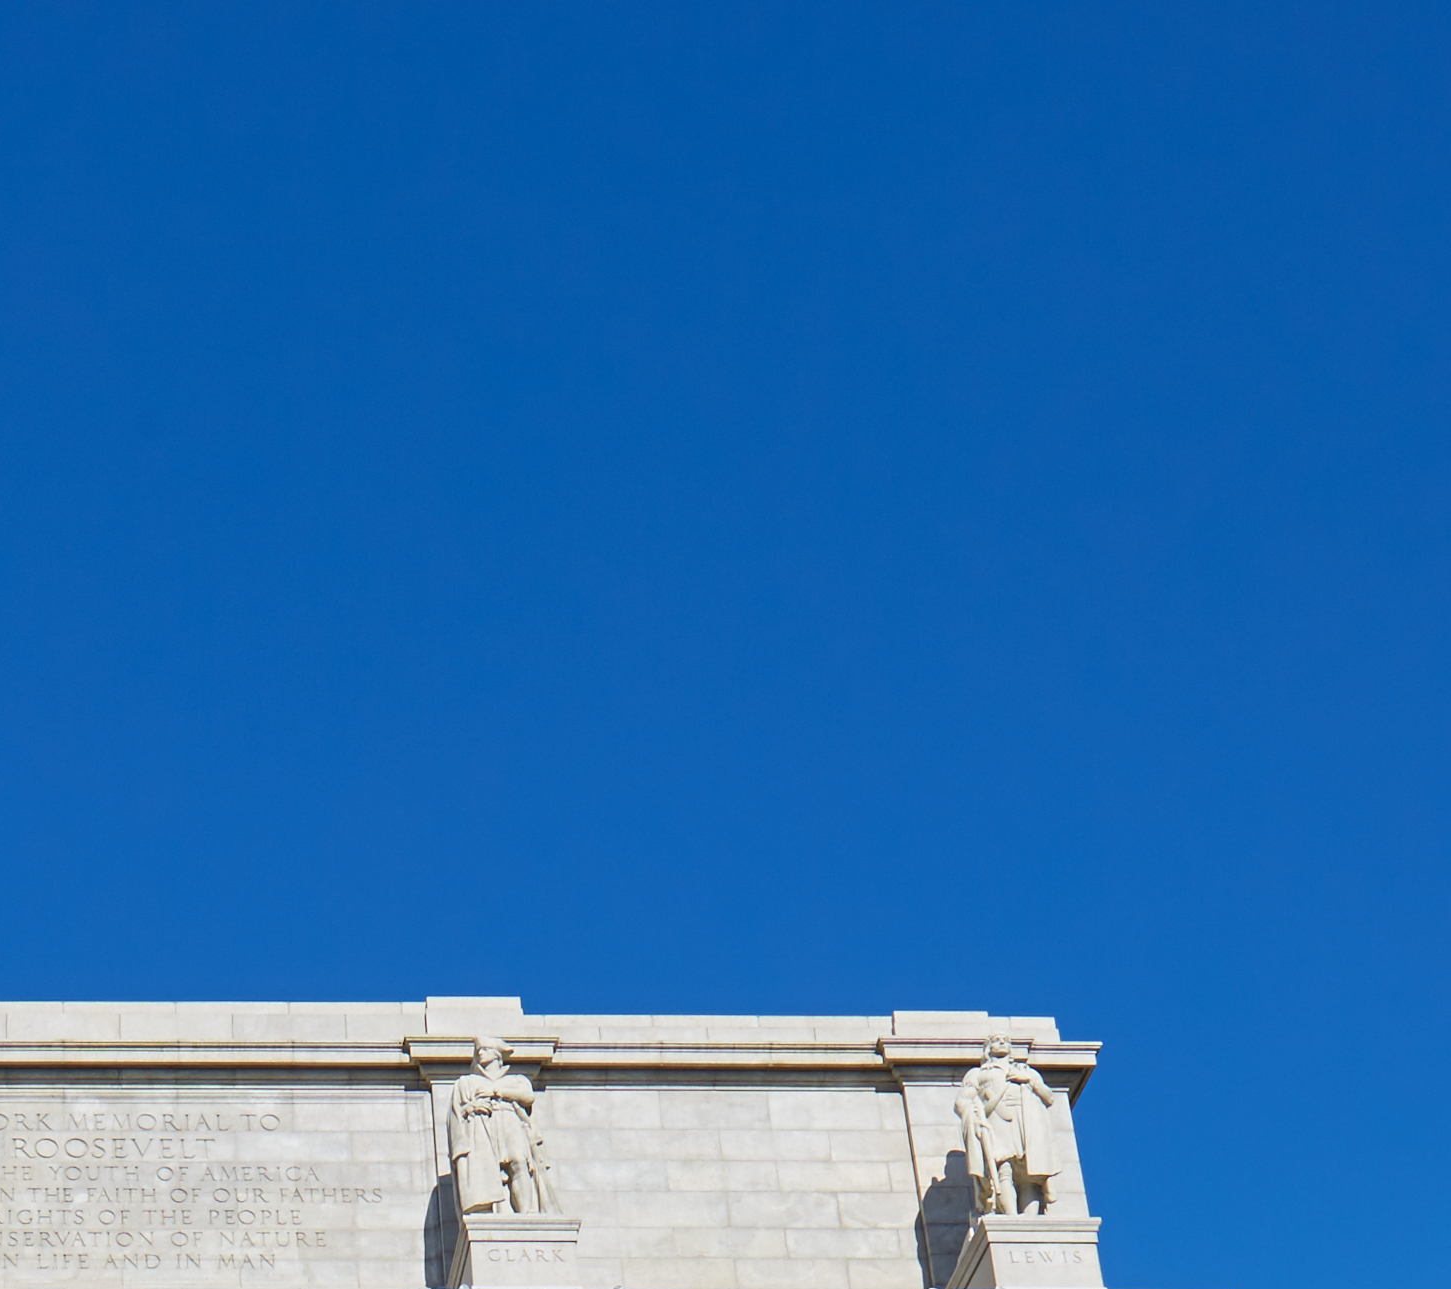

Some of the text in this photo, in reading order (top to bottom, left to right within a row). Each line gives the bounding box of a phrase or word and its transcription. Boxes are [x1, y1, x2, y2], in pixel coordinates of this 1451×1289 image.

[69, 1113, 233, 1131] MEMORIAL
[240, 1113, 282, 1131] TO
[11, 1137, 215, 1159] ROOSEVELT
[49, 1166, 140, 1182] YOUTH
[156, 1166, 189, 1182] OF
[201, 1166, 321, 1182] AMERICA
[27, 1187, 75, 1203] THE
[87, 1187, 157, 1203] FAITH
[169, 1187, 203, 1203] OF
[212, 1187, 269, 1203] OUR
[279, 1187, 383, 1203] FATHERS
[97, 1209, 131, 1225] OF
[142, 1209, 193, 1225] THE
[209, 1209, 302, 1225] PEOPLE
[170, 1231, 203, 1247] OF
[220, 1231, 327, 1247] NATURE
[36, 1253, 90, 1269] LIFE
[102, 1253, 161, 1269] AND
[175, 1253, 202, 1269] IN
[218, 1253, 276, 1269] MAN
[487, 1248, 566, 1262] CLARK
[1009, 1250, 1083, 1264] LEWIS
